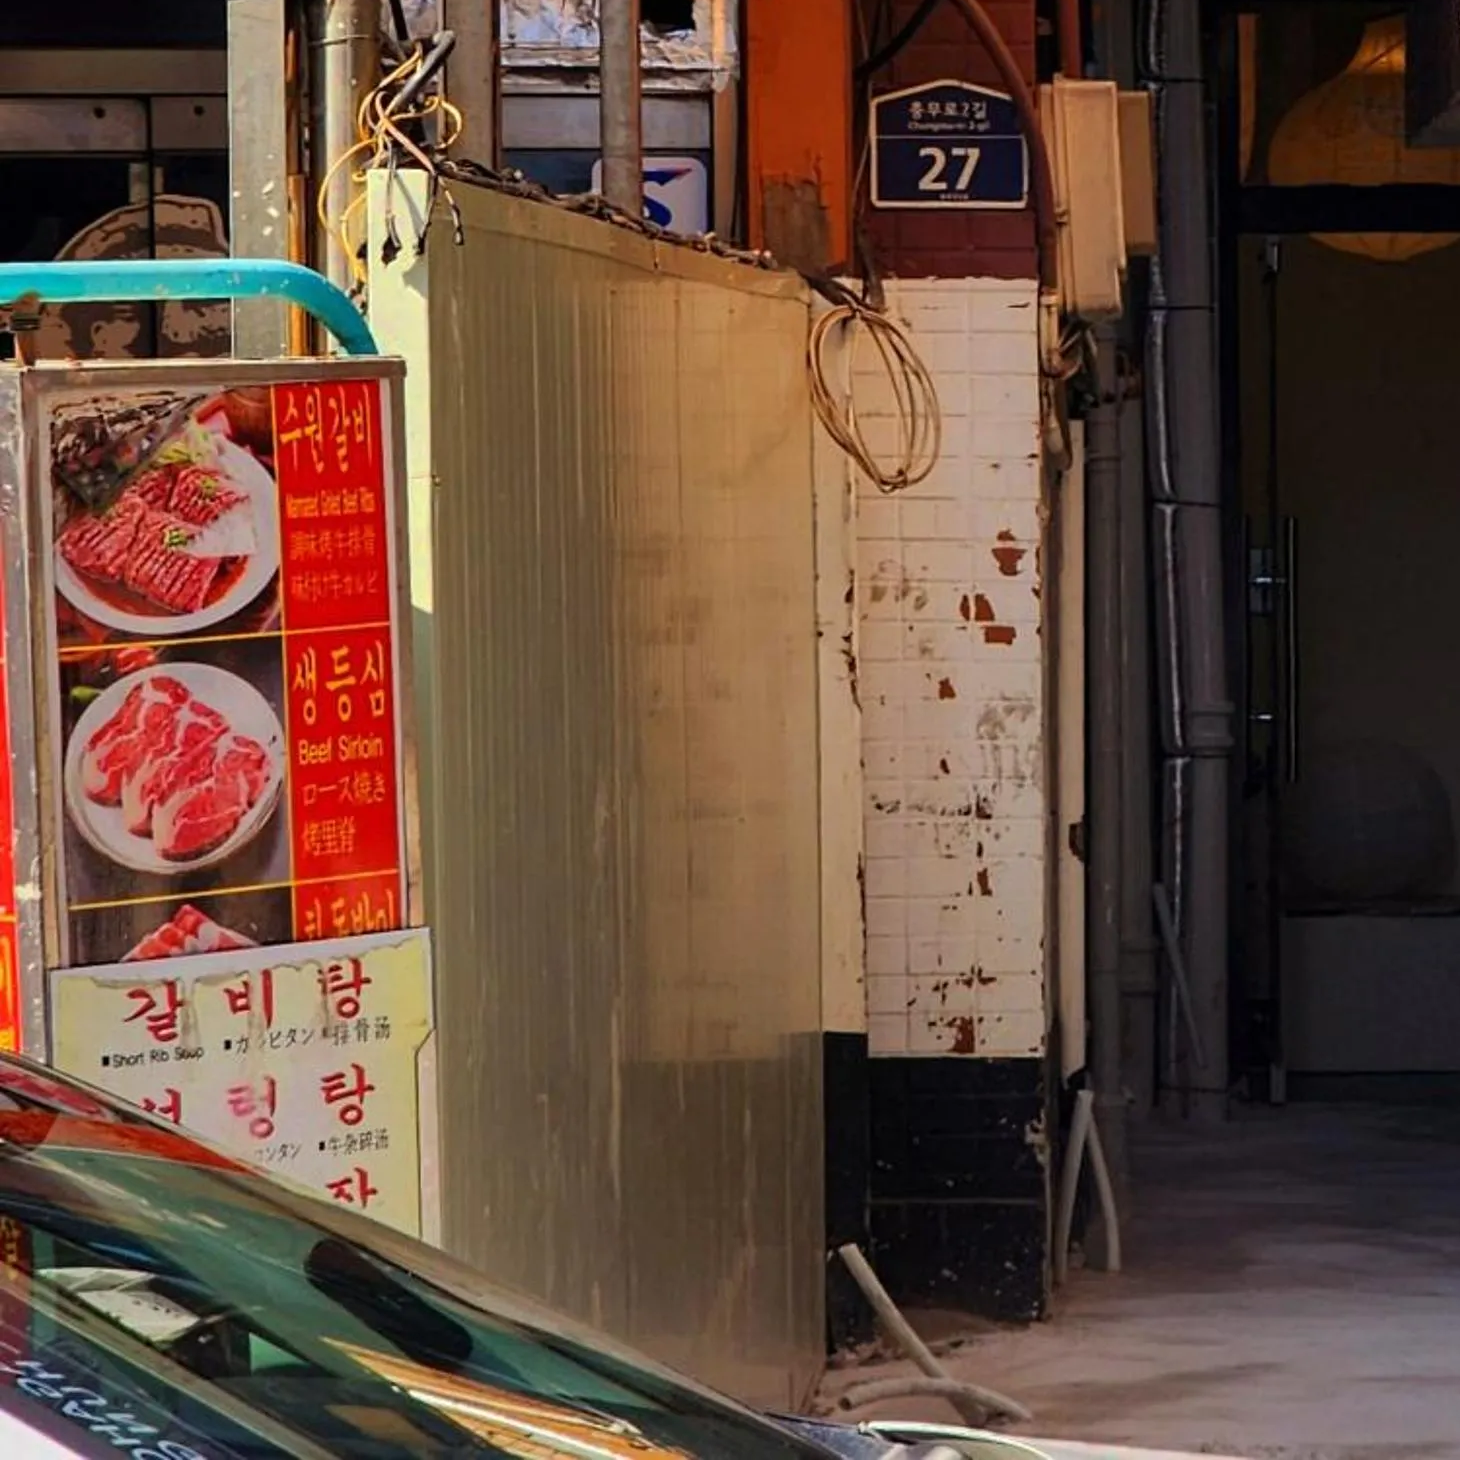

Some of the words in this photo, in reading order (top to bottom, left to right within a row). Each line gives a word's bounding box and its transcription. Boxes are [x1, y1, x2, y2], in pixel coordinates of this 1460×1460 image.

[918, 146, 981, 191] 27
[280, 383, 374, 474] 수원갈비
[292, 639, 385, 726] 생등심
[299, 736, 333, 765] Beef
[150, 1049, 170, 1063] Rib
